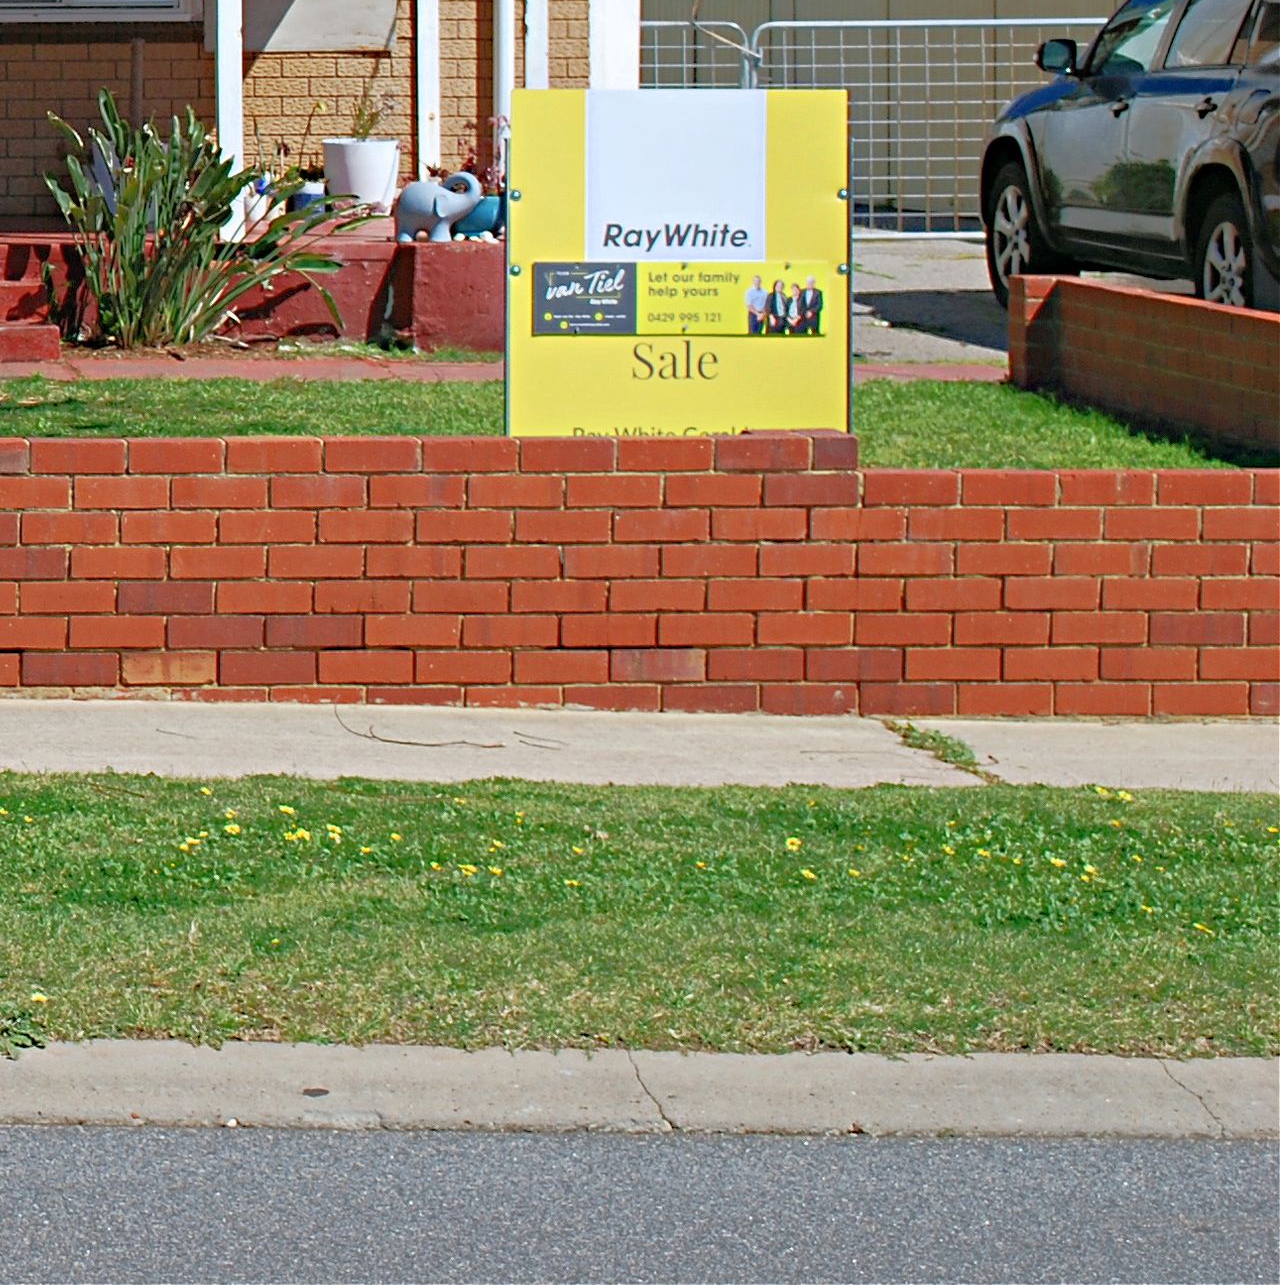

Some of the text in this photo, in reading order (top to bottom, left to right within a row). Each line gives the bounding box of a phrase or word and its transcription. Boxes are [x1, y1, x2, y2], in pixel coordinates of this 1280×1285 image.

[583, 269, 625, 294] Tiel
[648, 272, 740, 284] Let our family
[648, 286, 719, 298] help yours
[647, 313, 675, 322] 0429
[704, 313, 721, 322] 121
[632, 340, 719, 380] Sale
